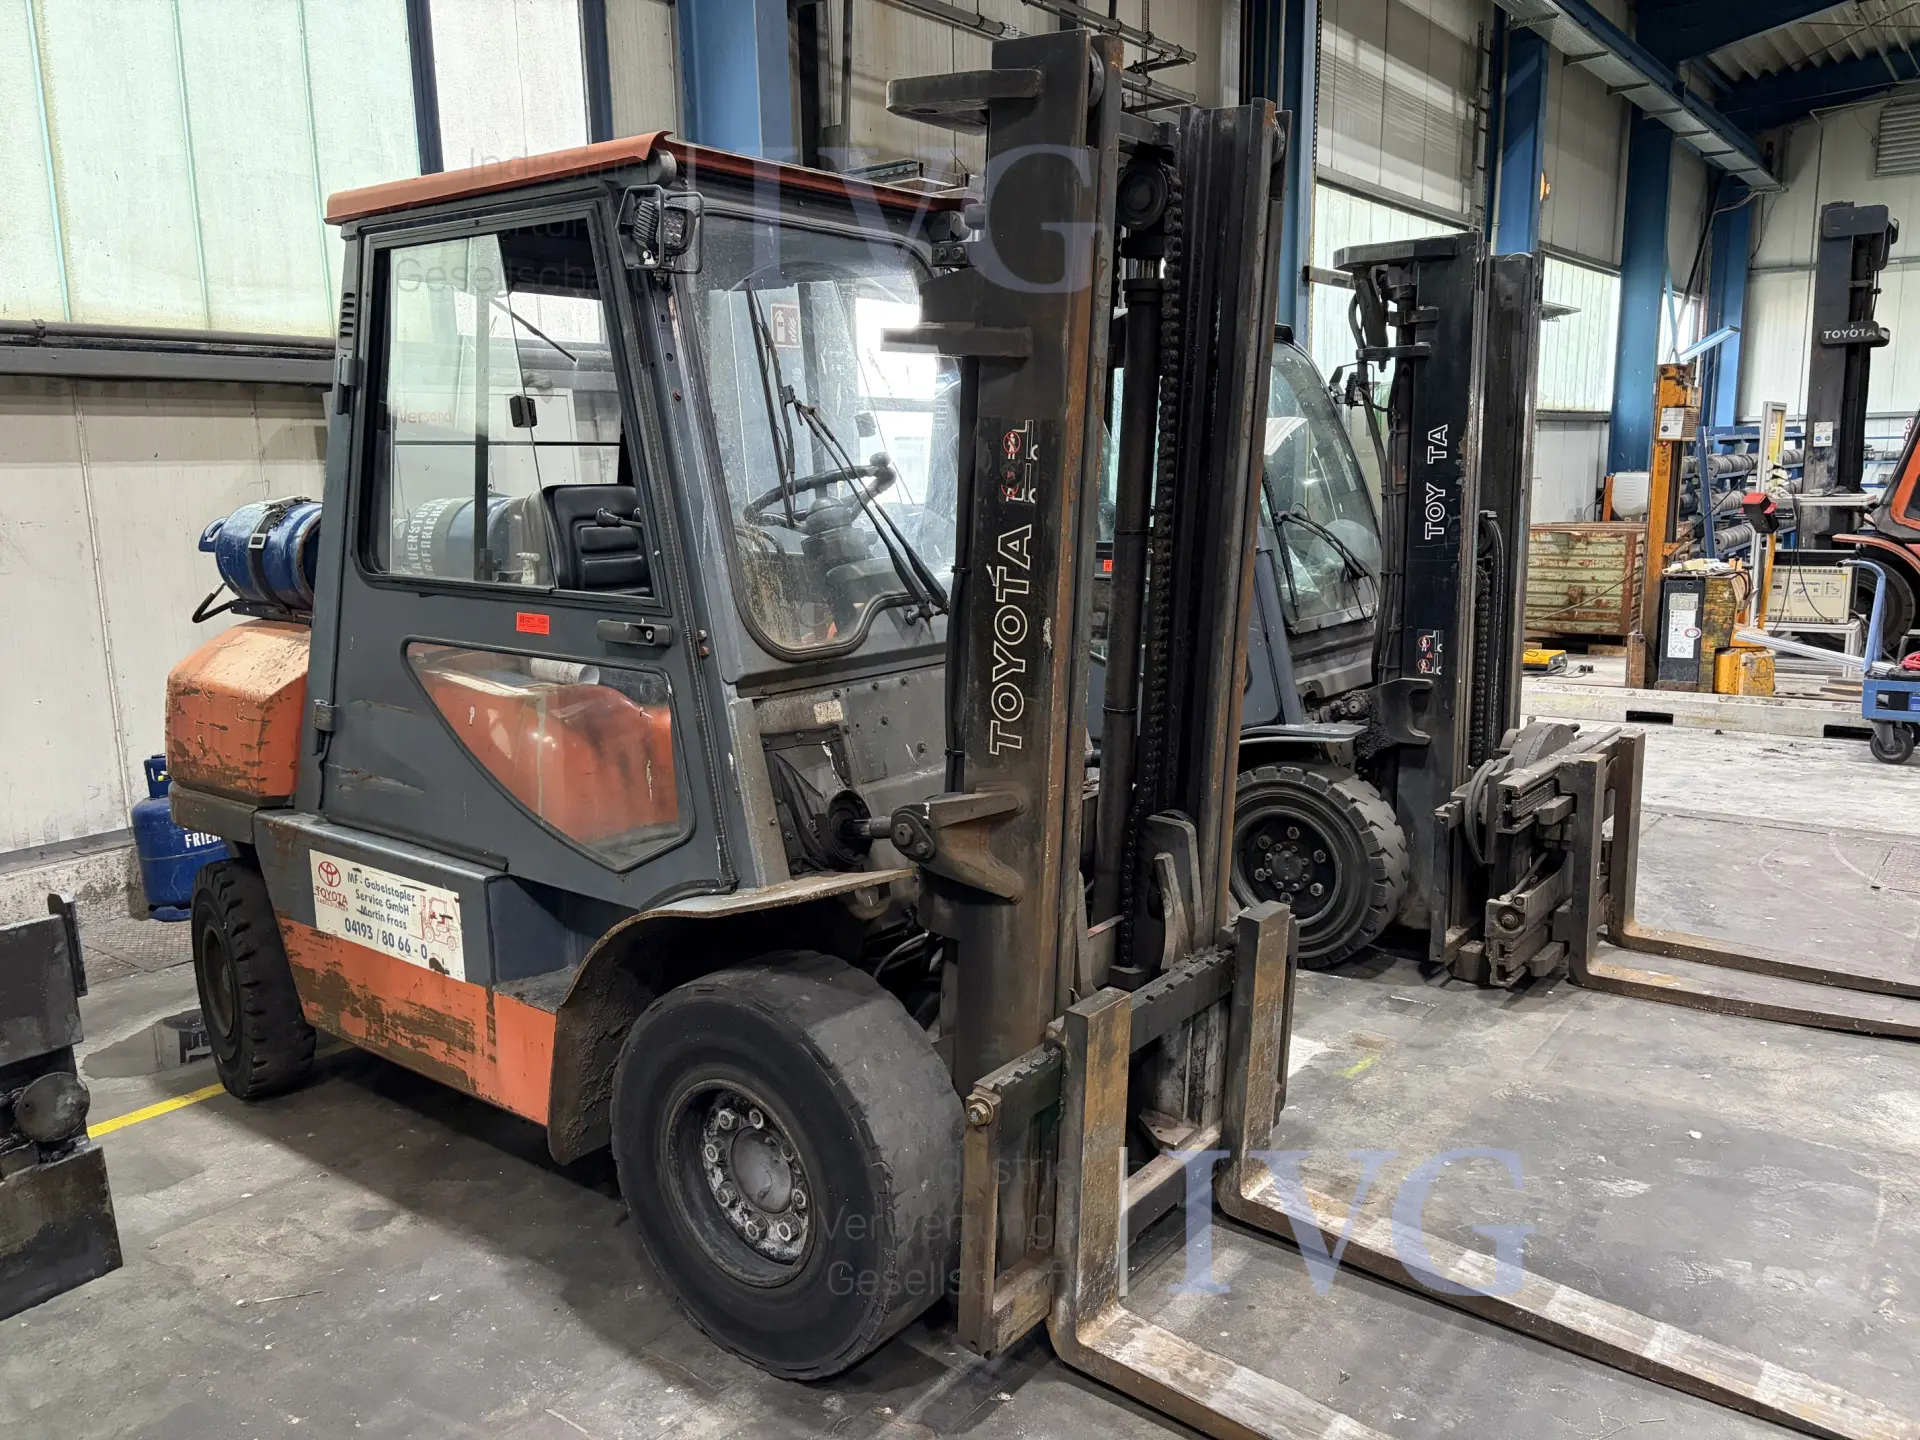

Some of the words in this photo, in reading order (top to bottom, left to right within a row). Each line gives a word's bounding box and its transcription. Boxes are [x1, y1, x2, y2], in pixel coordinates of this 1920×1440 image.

[989, 523, 1032, 756] TOYOTA
[314, 885, 348, 906] TOYOTA
[355, 888, 384, 908] Service
[385, 898, 410, 916] GmbH
[364, 877, 416, 903] Gabelstapler
[359, 904, 386, 923] Martin
[344, 917, 374, 940] 04193
[381, 929, 395, 948] 80
[397, 935, 411, 954] 66
